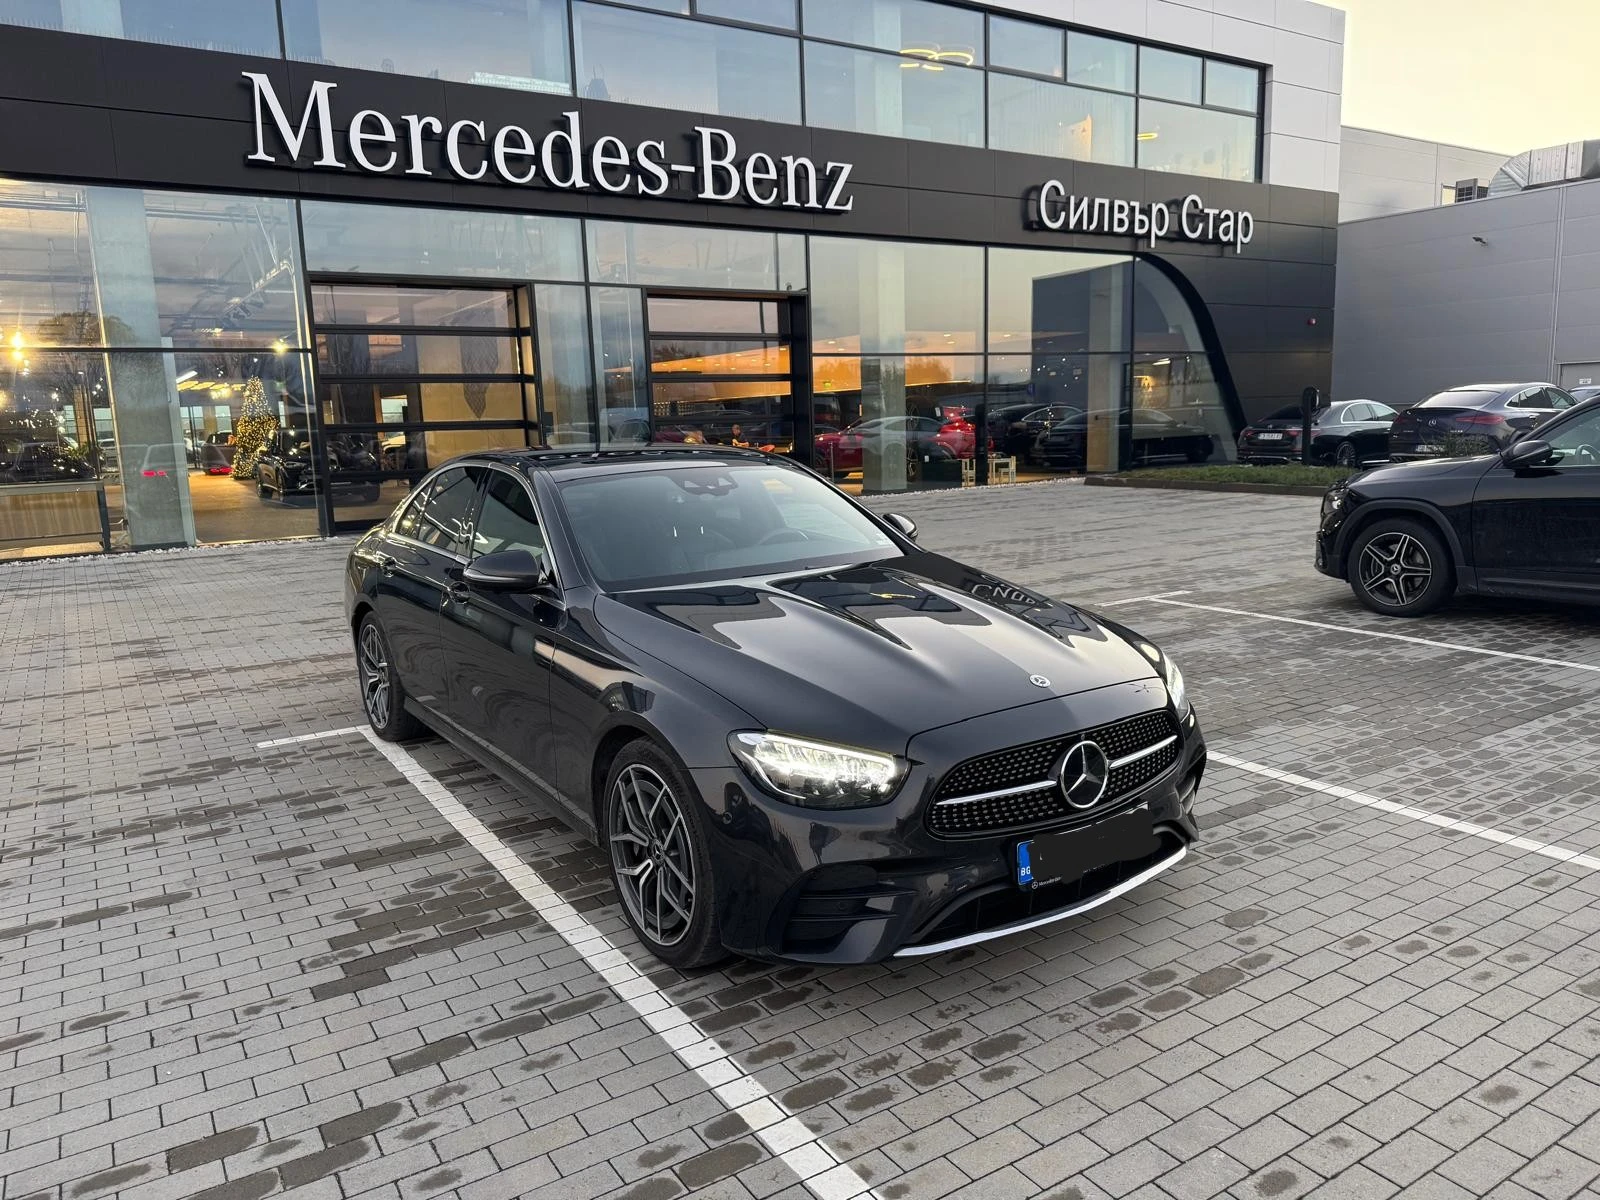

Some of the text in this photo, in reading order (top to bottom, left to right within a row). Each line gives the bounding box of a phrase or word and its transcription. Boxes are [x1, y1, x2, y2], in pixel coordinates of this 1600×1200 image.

[241, 71, 854, 212] Mercedes-Benz
[1040, 179, 1254, 254] Силвър Стар
[1020, 866, 1031, 877] BG
